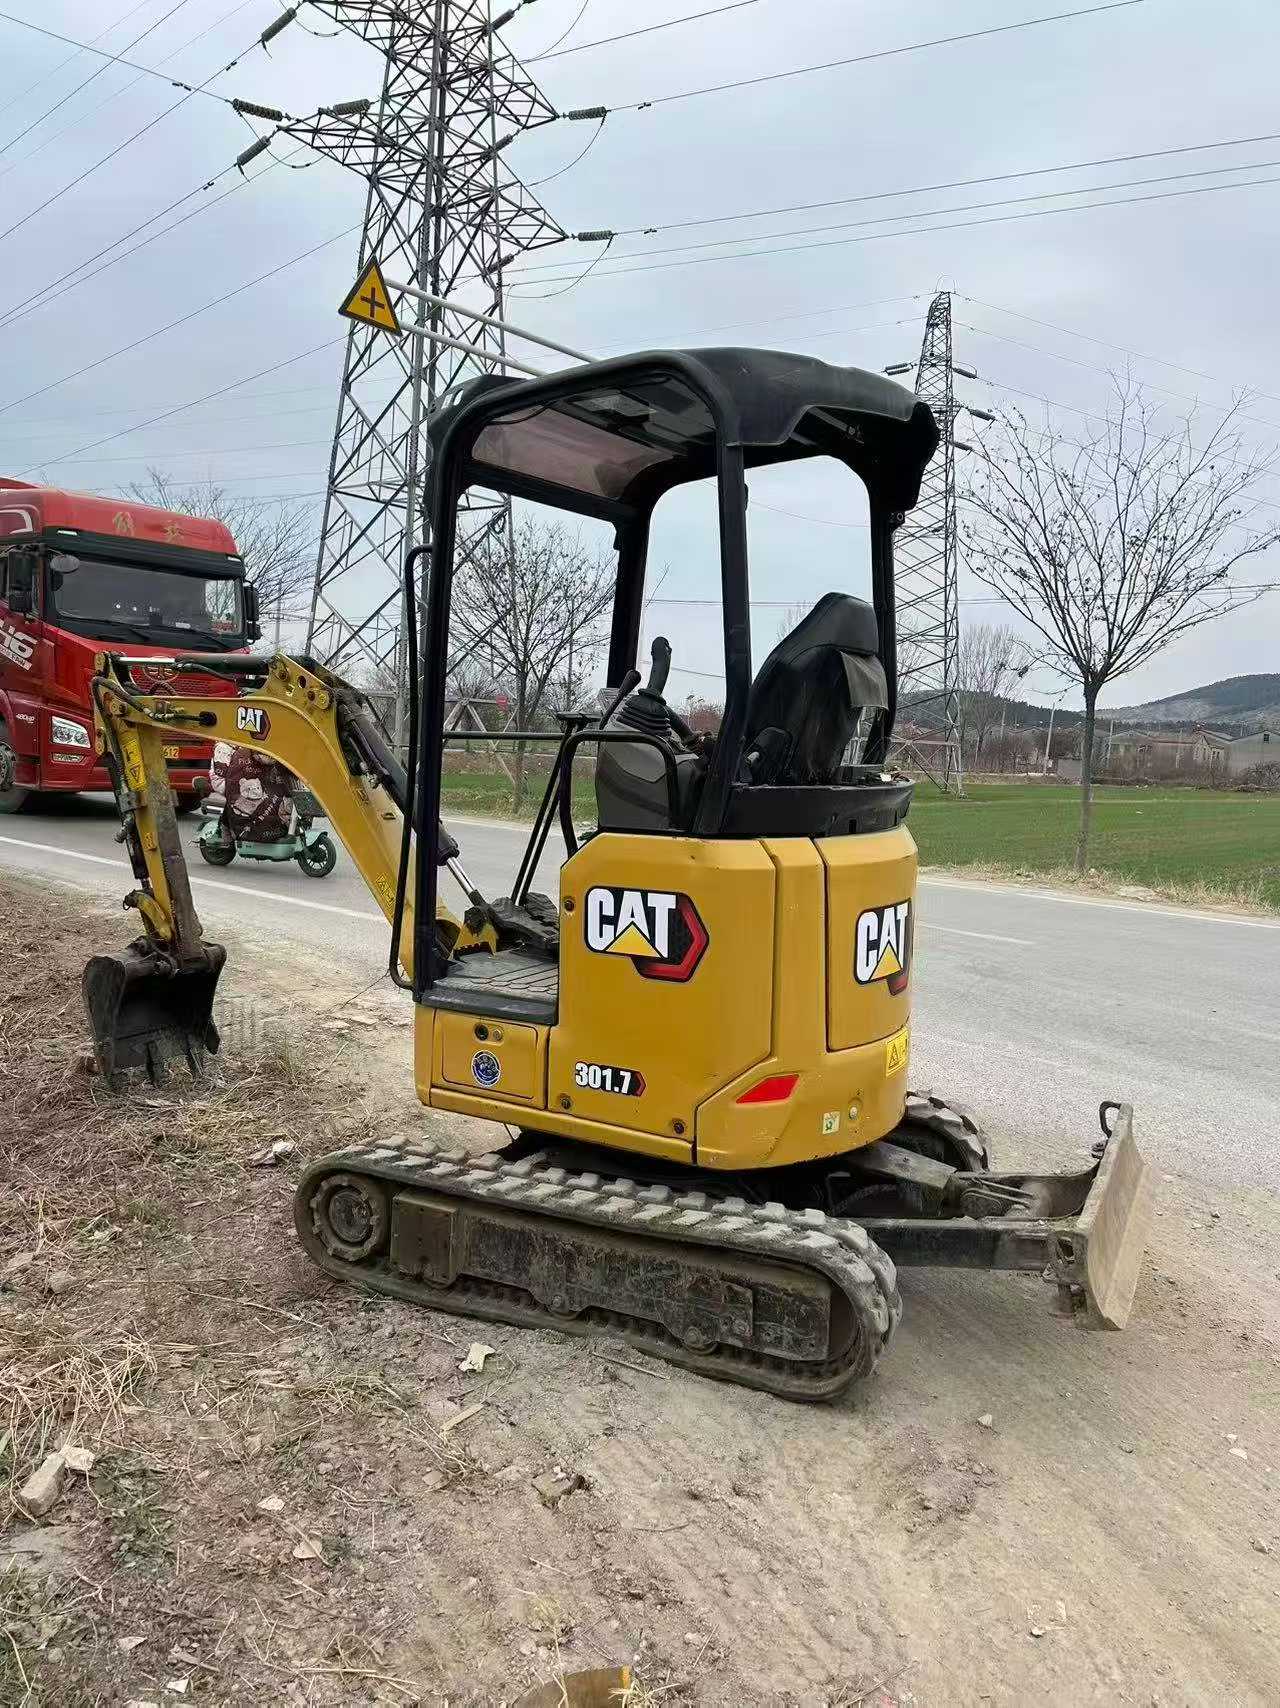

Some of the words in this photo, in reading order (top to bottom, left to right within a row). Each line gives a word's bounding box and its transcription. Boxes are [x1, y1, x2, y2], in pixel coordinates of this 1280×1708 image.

[237, 706, 263, 733] CAT
[587, 888, 677, 958] CAT
[857, 903, 909, 982] CAT
[575, 1063, 633, 1094] 301.7
